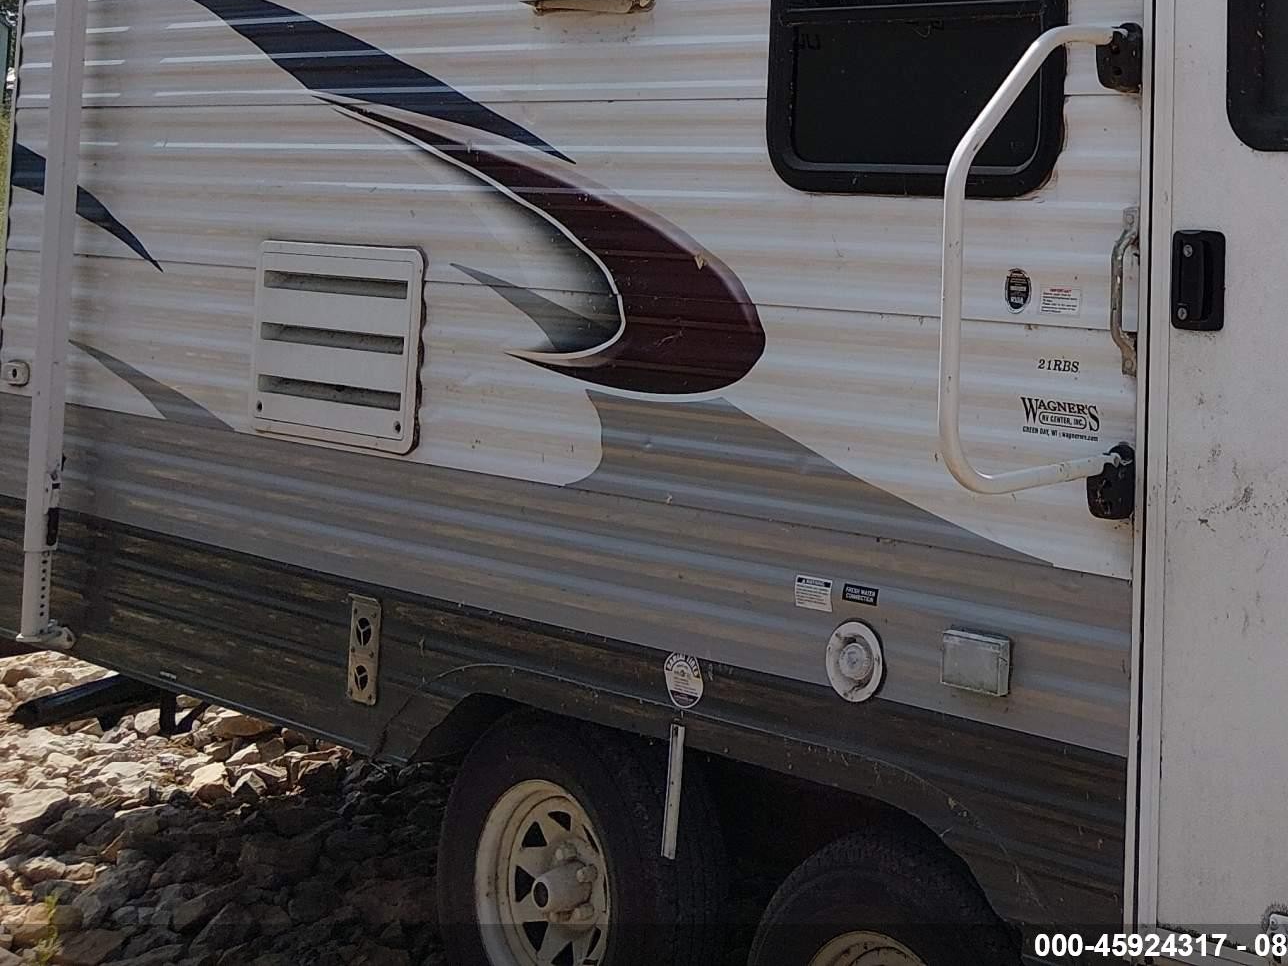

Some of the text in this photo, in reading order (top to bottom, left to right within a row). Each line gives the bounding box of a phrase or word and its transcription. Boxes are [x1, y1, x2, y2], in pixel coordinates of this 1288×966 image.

[1038, 359, 1080, 373] 21RBS
[1020, 397, 1100, 432] WAGNER'S
[1041, 414, 1049, 422] RV
[1022, 426, 1038, 434] GREEN
[845, 586, 876, 597] FRESH WATER
[845, 593, 874, 603] CONNECTION
